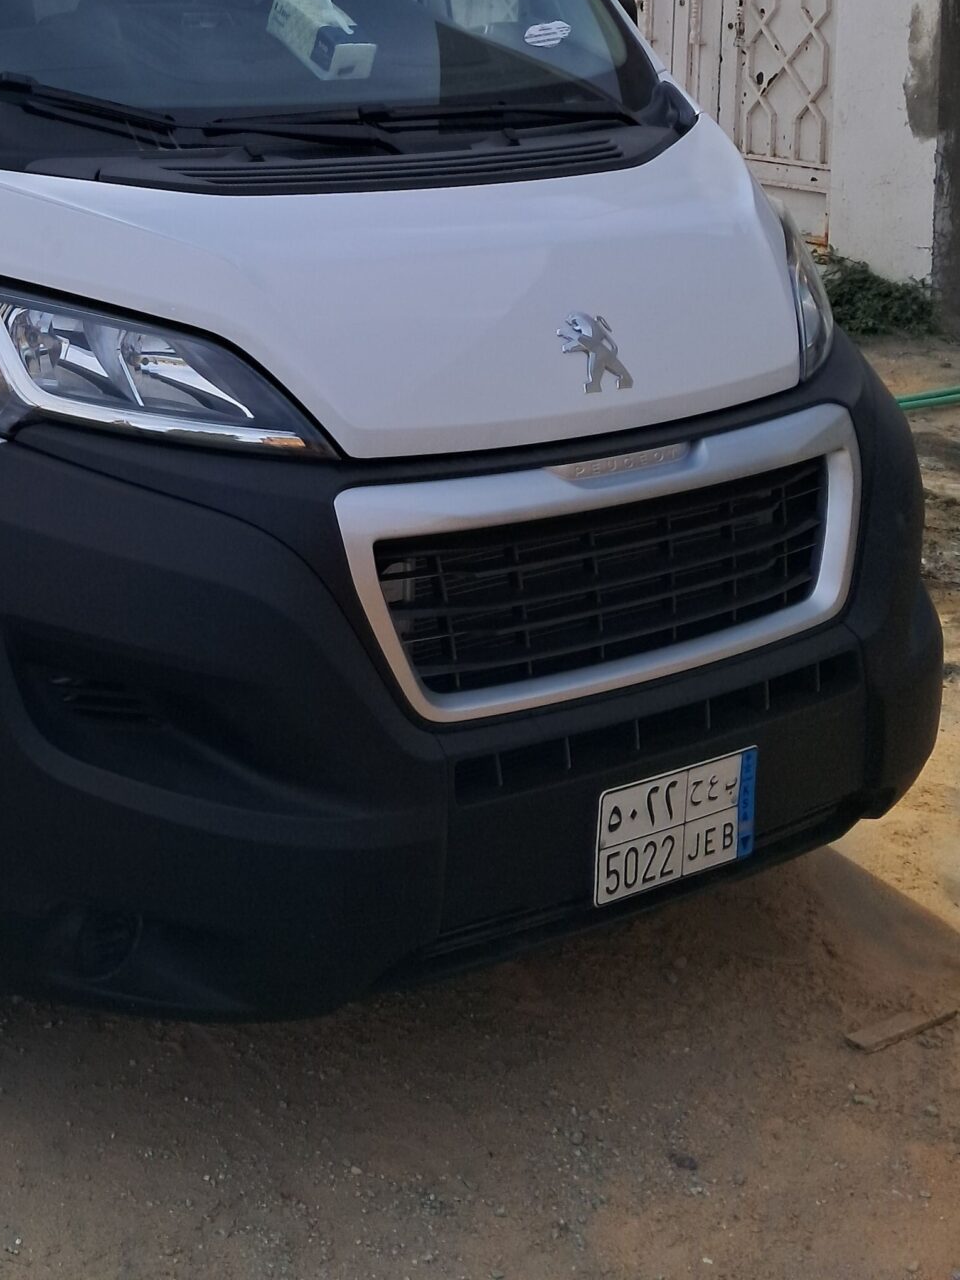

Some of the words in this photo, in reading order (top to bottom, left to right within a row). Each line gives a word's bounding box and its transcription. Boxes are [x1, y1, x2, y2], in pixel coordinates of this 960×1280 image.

[575, 449, 679, 477] PEUGEOT
[605, 835, 676, 895] 5022
[687, 822, 735, 861] JEB
